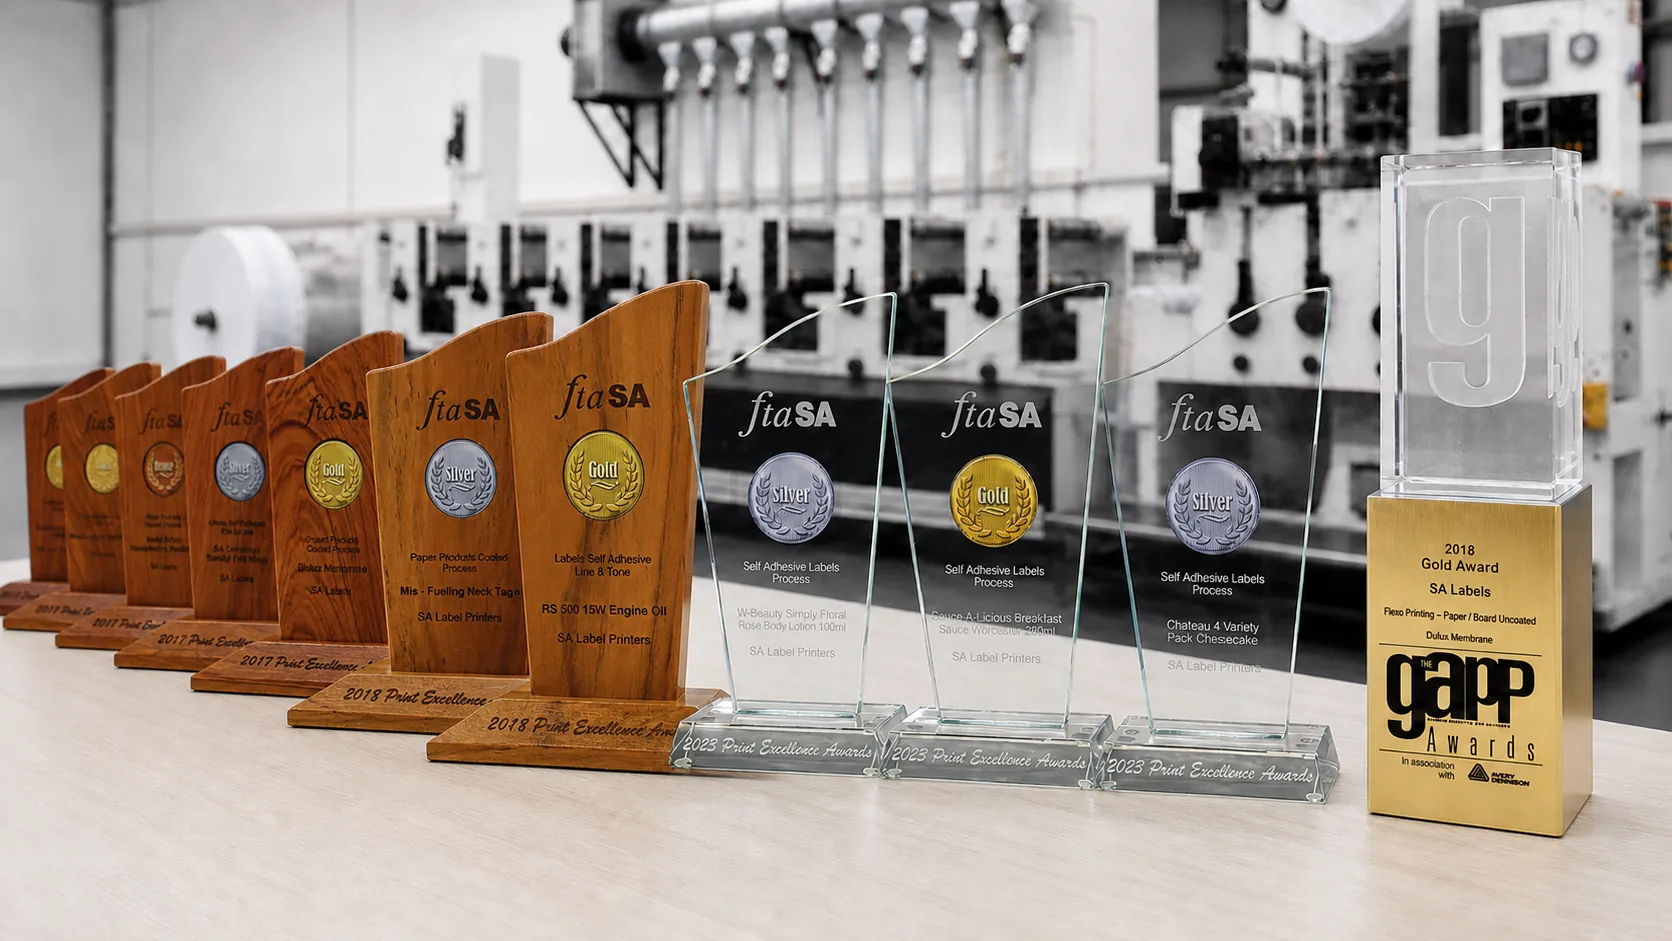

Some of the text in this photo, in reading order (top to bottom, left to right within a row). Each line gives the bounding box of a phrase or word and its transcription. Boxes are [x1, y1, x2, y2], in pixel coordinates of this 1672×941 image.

[1424, 195, 1526, 408] g
[554, 374, 651, 420] ftaSA
[303, 393, 368, 429] ftaSA
[416, 389, 501, 431] ftaSA
[738, 390, 837, 438] ftaSA
[941, 390, 1043, 438] ftaSA
[1157, 393, 1262, 442] ftaSA
[323, 462, 345, 477] Gold
[445, 465, 477, 482] Silver
[588, 460, 619, 479] Gold
[977, 486, 1009, 504] Gold
[1192, 491, 1233, 511] Silver
[1445, 543, 1475, 556] 2018
[410, 552, 437, 563] Paper
[554, 553, 652, 564] Labels Self Adhesive
[442, 563, 477, 573] Process
[575, 566, 631, 577] Line & Tone
[743, 560, 840, 573] Self Adhesive Labels
[944, 564, 1045, 576] Self Adhesive Labels
[1421, 558, 1499, 574] Gold Award
[772, 573, 811, 584] Process
[974, 576, 1014, 588] Process
[1160, 571, 1265, 584] Self Adhesive Labels
[400, 586, 419, 596] Mis
[427, 586, 465, 598] Fueling
[467, 586, 493, 596] Neck
[1192, 584, 1233, 596] Process
[1429, 582, 1491, 598] SA Labels
[417, 611, 503, 623] SA Label Printers
[542, 604, 558, 614] RS
[560, 604, 580, 614] 500
[582, 604, 607, 615] 15W
[609, 604, 648, 618] Engine
[737, 607, 847, 621] W-Beauty Simply Floral
[1384, 607, 1404, 617] Flexo
[1405, 608, 1435, 620] Printing
[1443, 611, 1467, 622] Paper
[1473, 613, 1497, 623] Board
[1498, 614, 1537, 625] Uncoated
[1014, 612, 1062, 624] Breakfast
[738, 620, 847, 632] Rose Body Lotion 100ml
[939, 624, 969, 634] Sauce
[1166, 619, 1260, 635] Chateau 4 Variety
[157, 634, 187, 645] 2017
[557, 632, 651, 645] SA Label Printers
[1167, 632, 1193, 643] Pack
[1426, 631, 1493, 644] Dulux Membrane
[749, 645, 836, 658] SA Label Printers
[952, 651, 1041, 664] SA Label Printers
[240, 655, 274, 667] 2017
[1168, 660, 1184, 670] SA
[1187, 660, 1216, 671] Label
[1420, 659, 1433, 668] THE
[343, 687, 487, 706] 2018 Print Excellence
[487, 716, 530, 733] 2018
[532, 717, 571, 735] Print
[573, 719, 645, 737] Excellence
[683, 737, 872, 758] 2023 Print Excellence Awards
[1427, 726, 1535, 762] Awards
[891, 747, 1087, 769] 2023 Print Excellence Awards
[1401, 757, 1409, 765] In
[1106, 758, 1314, 783] 2023 Print Excellence Awards
[1438, 771, 1455, 780] with
